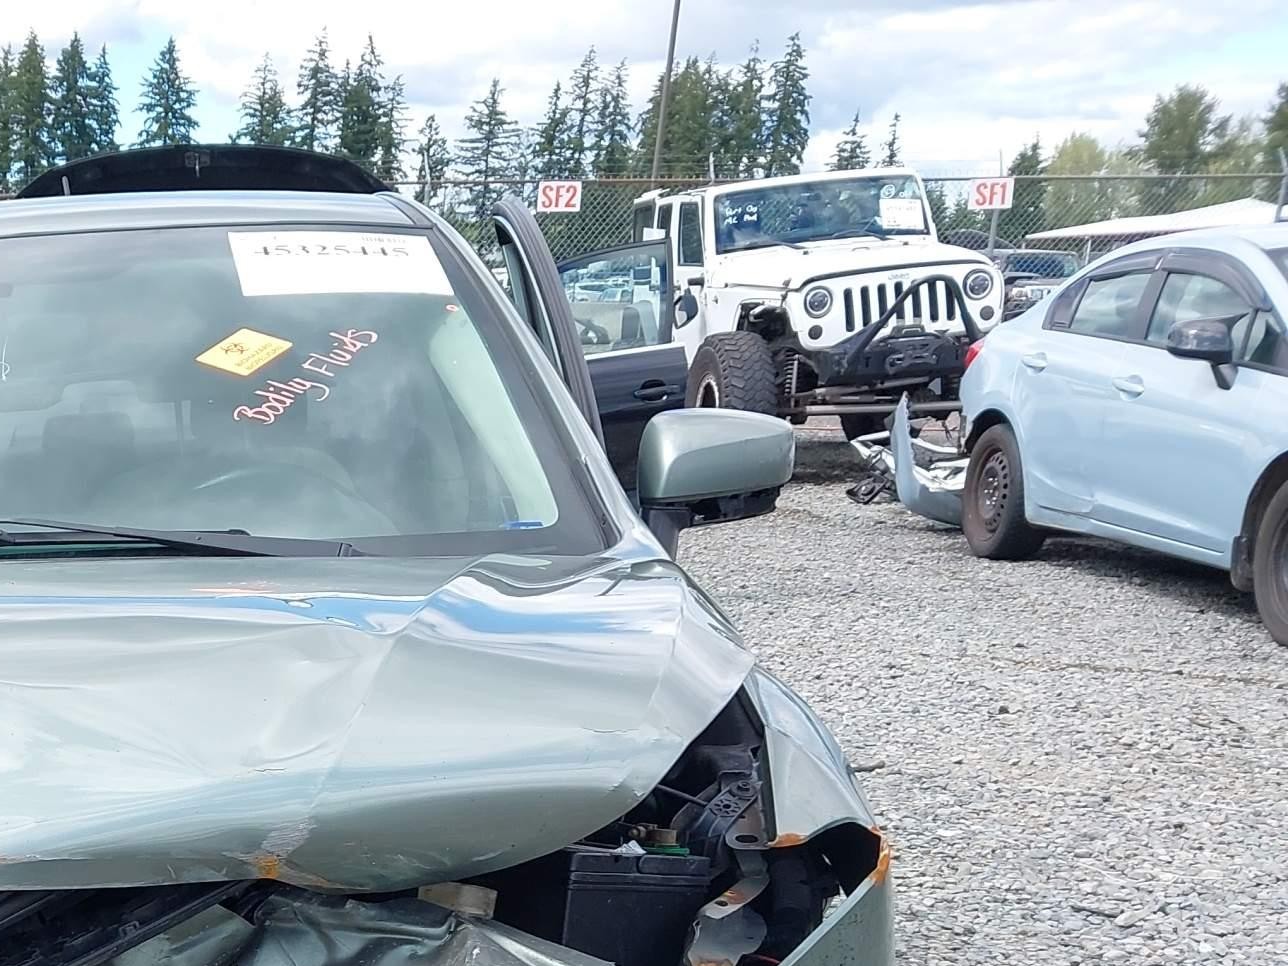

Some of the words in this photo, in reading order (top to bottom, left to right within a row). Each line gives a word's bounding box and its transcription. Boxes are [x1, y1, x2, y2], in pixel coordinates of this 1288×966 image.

[541, 184, 578, 209] SF2
[975, 182, 1008, 206] SF1
[253, 243, 410, 257] 45325445
[233, 377, 331, 425] Bodily
[300, 328, 379, 377] Fluids
